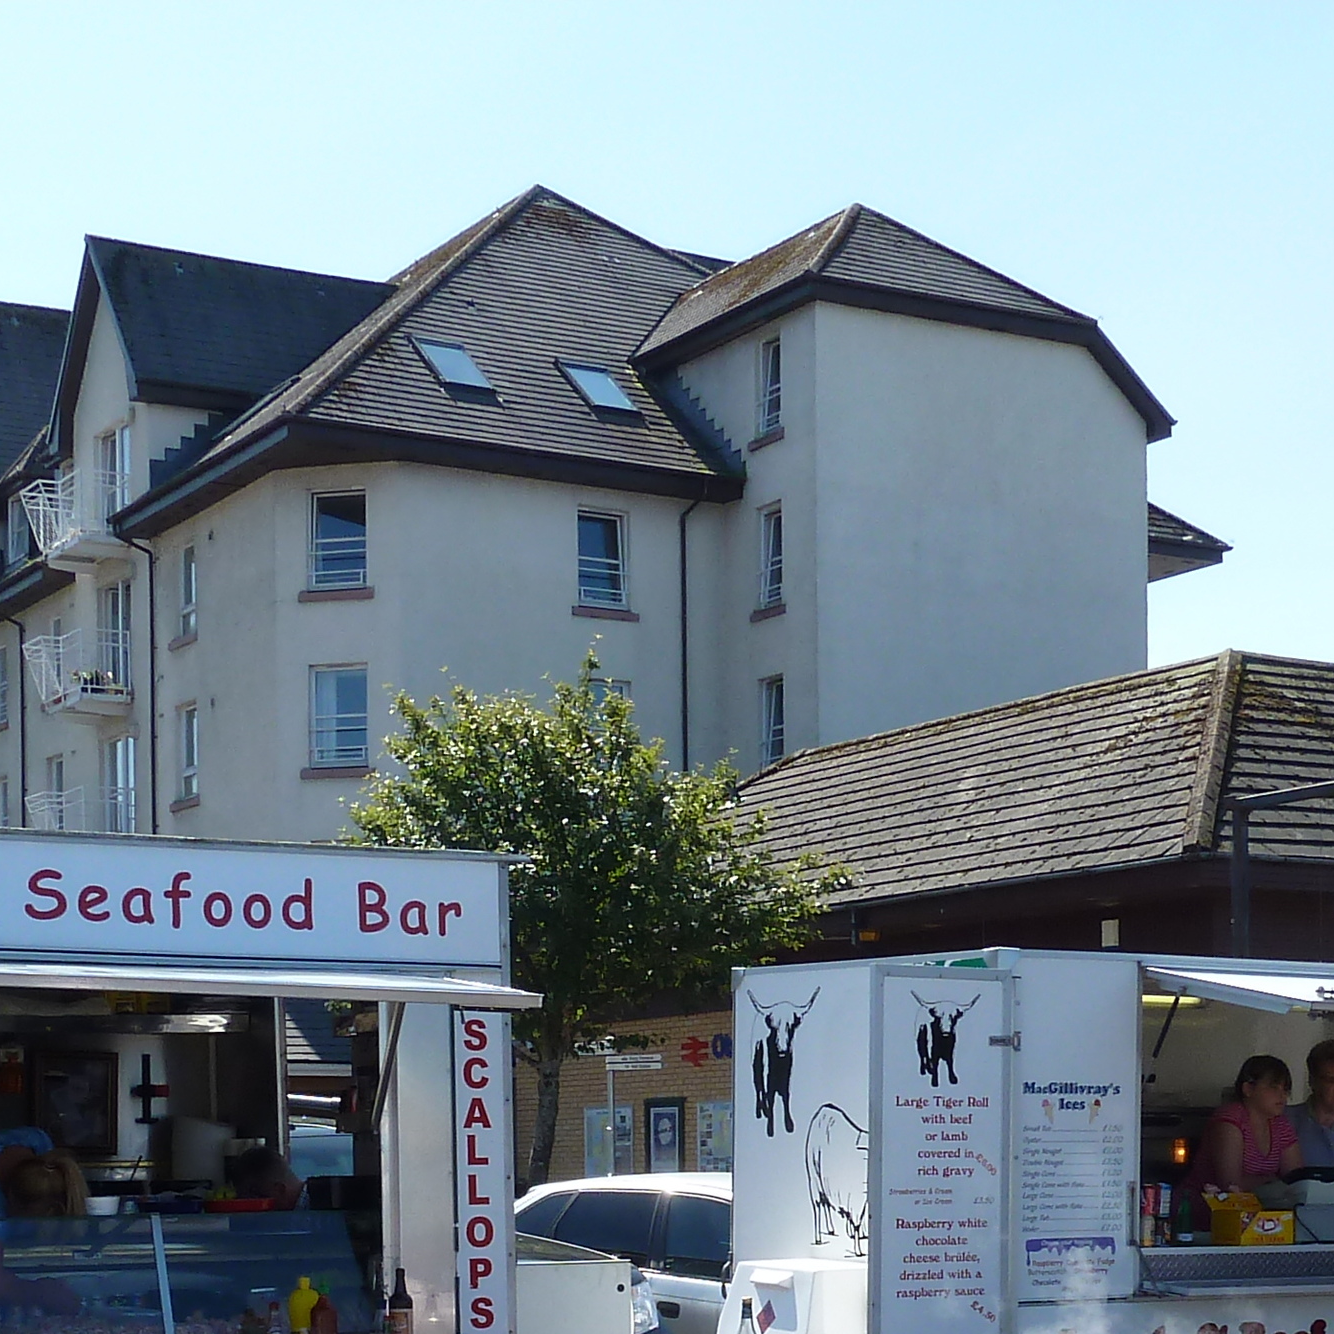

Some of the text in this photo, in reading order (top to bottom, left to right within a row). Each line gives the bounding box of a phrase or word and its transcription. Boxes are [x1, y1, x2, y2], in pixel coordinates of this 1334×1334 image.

[24, 868, 314, 931] Seafood
[359, 881, 462, 938] Bar
[1022, 1081, 1121, 1097] MacGillivray's
[895, 1095, 989, 1109] Large Tiger Roll
[1058, 1098, 1086, 1111] Ices
[921, 1113, 973, 1125] with beef
[925, 1131, 968, 1142] or lamb
[917, 1148, 975, 1159] covered in
[462, 1019, 495, 1329] SCALLOPS
[917, 1166, 975, 1178] rich gravy
[895, 1217, 988, 1231] Raspberry white
[915, 1235, 968, 1247] chocolate
[902, 1252, 941, 1263] cheese
[899, 1269, 983, 1281] drizzled with a
[896, 1287, 985, 1301] raspberry sauce
